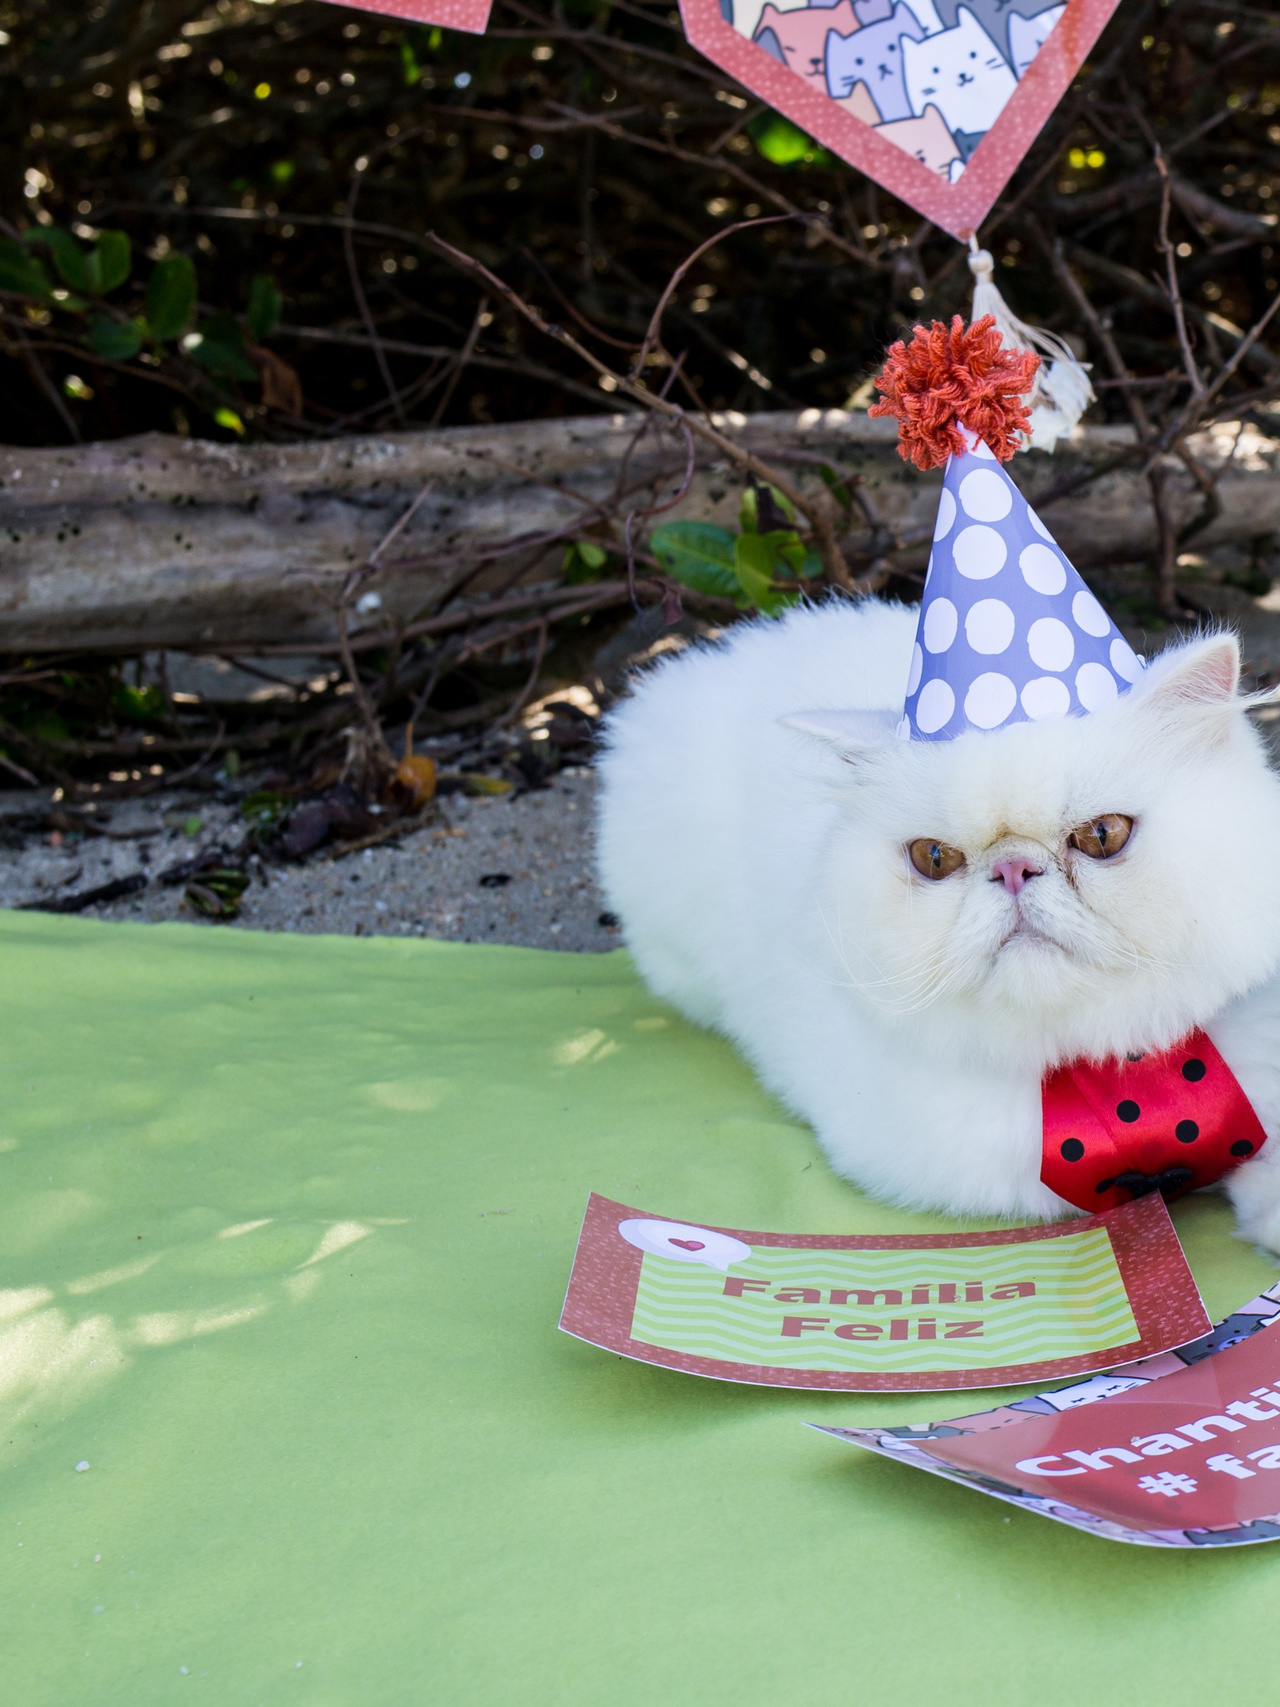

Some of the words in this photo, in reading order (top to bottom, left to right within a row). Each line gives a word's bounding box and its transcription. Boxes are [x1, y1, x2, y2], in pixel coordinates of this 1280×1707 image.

[722, 1276, 1037, 1306] Família
[780, 1315, 985, 1341] Feliz
[1137, 1470, 1198, 1497] #
